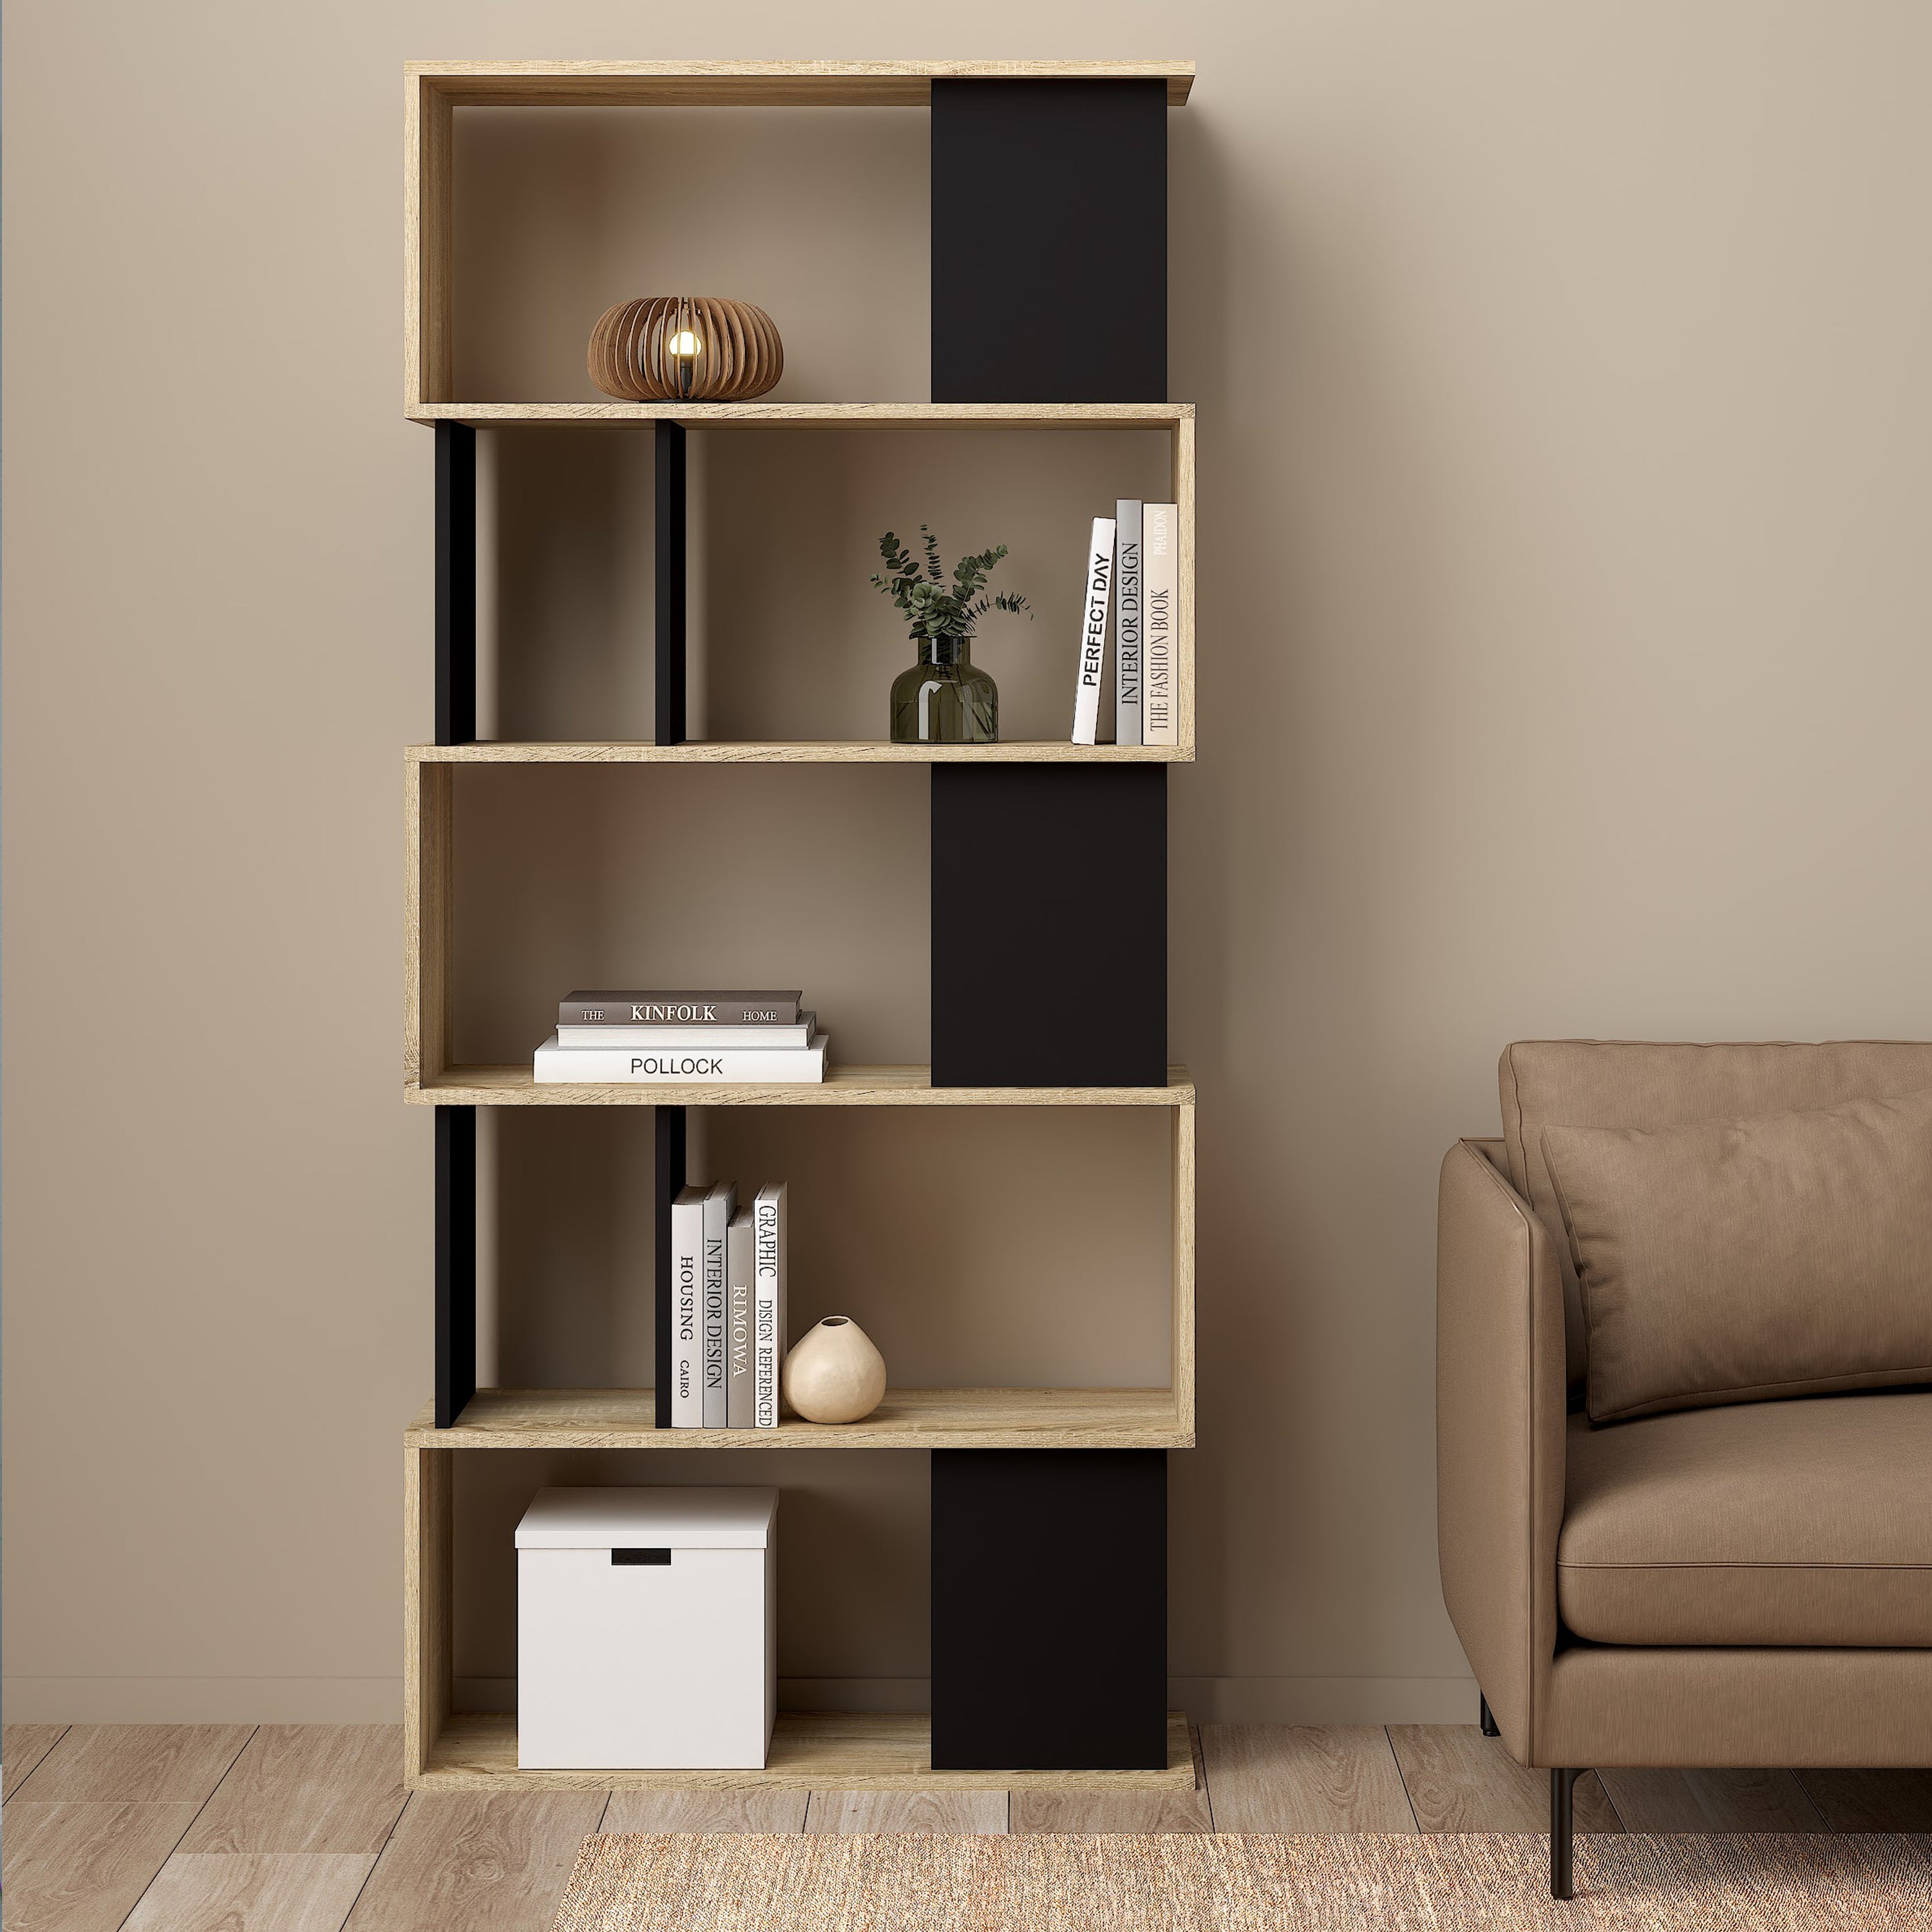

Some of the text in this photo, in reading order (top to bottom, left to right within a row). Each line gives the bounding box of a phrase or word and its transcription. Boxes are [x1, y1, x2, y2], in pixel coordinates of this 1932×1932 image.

[1154, 510, 1167, 556] PHAIDON
[1083, 553, 1110, 687] PERFECT DAY
[1122, 543, 1138, 705] INTERIOR DESIGN
[1150, 589, 1168, 732] THE FASHION BOOK
[581, 1005, 777, 1021] THE KINFOLK HOME
[631, 1058, 723, 1074] POLLOCK
[759, 1205, 776, 1278] GRAPHIC
[680, 1256, 693, 1341] HOUSING
[706, 1238, 722, 1389] INTERIOR DESIGN
[733, 1284, 747, 1378] RIMOWA
[680, 1359, 689, 1399] CAIRO
[759, 1300, 772, 1427] DISIGN REFERENCED
